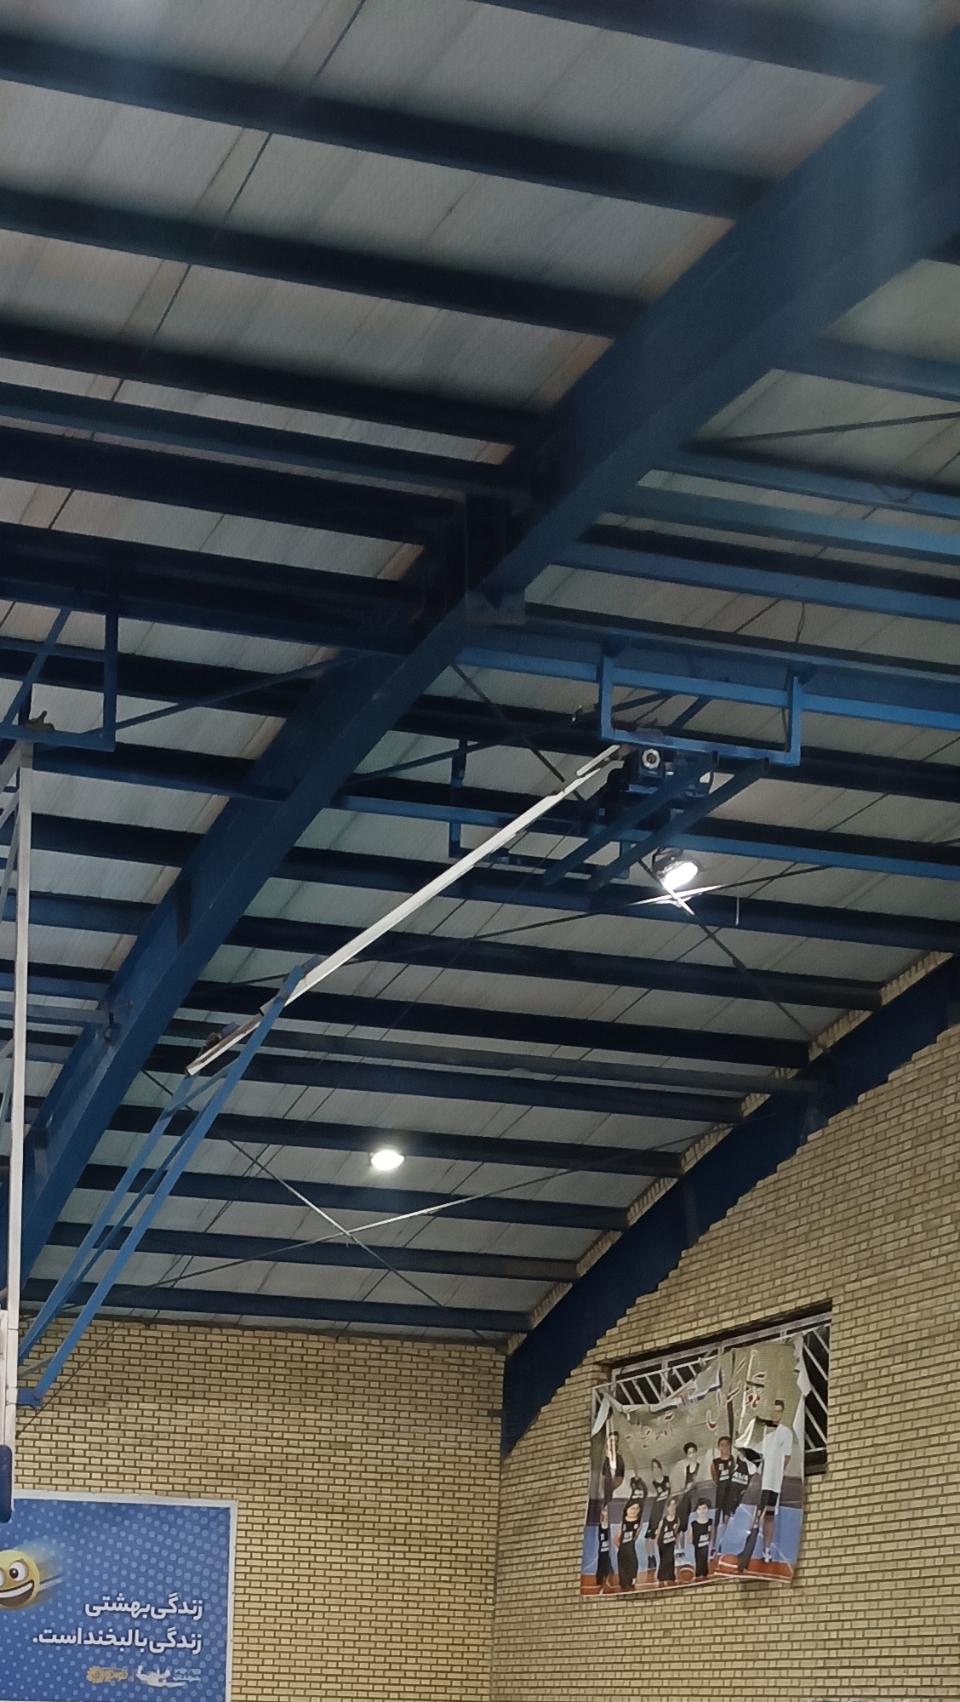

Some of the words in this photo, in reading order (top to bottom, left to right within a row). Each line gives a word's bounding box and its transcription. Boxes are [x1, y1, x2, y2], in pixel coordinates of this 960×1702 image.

[85, 1592, 151, 1619] بهشتی
[151, 1592, 203, 1620] زندگی
[33, 1626, 82, 1647] است.
[83, 1628, 133, 1652] لبخند
[135, 1628, 148, 1653] با
[149, 1626, 202, 1655] زندگی
